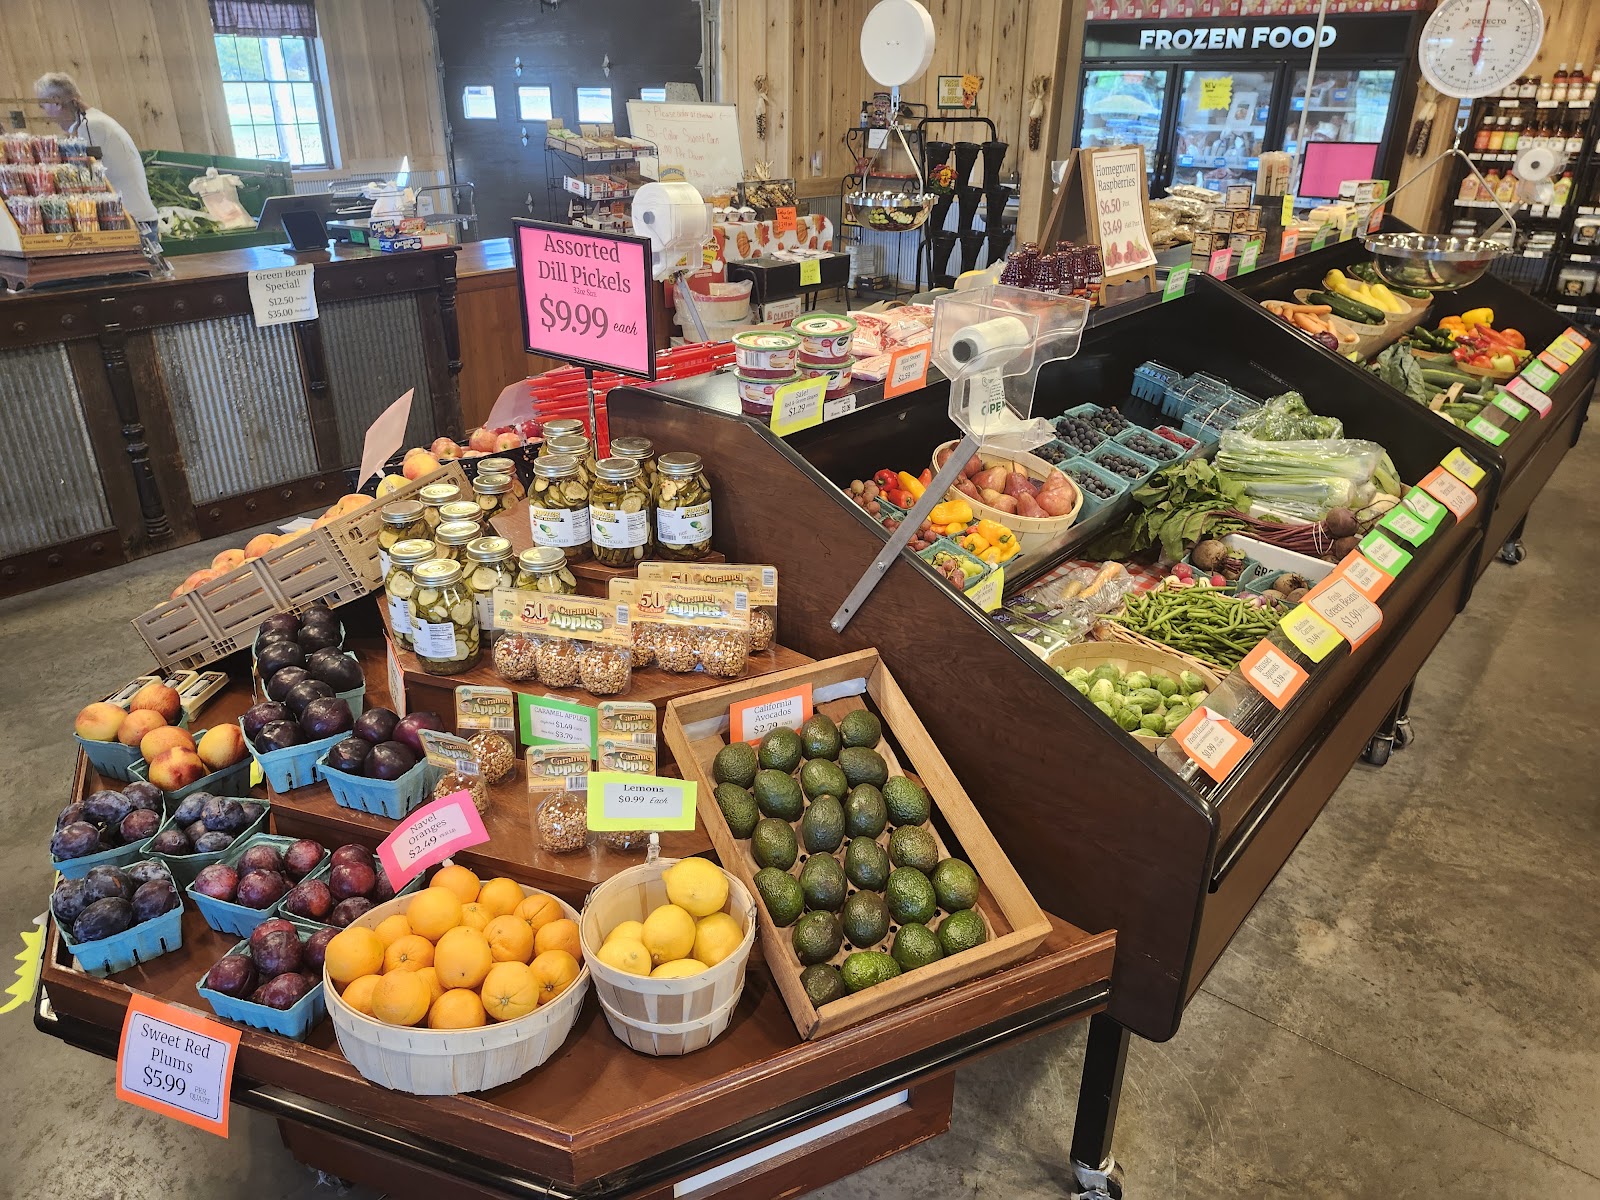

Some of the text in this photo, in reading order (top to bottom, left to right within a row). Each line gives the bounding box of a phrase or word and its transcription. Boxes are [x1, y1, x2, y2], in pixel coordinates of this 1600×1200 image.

[1139, 25, 1337, 50] FROZEN FOOD
[1096, 163, 1136, 178] Homegrown
[1098, 176, 1136, 193] Raspberries
[1100, 198, 1120, 215] $6.50
[1102, 219, 1122, 236] $3.49
[544, 234, 620, 263] Assorted
[256, 269, 307, 281] Green Bean
[538, 260, 631, 294] Dill Pickels
[266, 279, 300, 293] Special!
[269, 296, 294, 307] $12.50
[268, 308, 293, 319] $35.00
[539, 293, 638, 339] $9.99 each
[774, 310, 794, 320] CLAEYS
[788, 404, 806, 418] $1.29
[1255, 565, 1273, 576] GR
[704, 573, 743, 583] Caramel
[640, 590, 715, 608] 50 Caramel
[1327, 591, 1342, 603] Fresh
[524, 600, 548, 620] 50
[557, 606, 598, 617] Caramel
[668, 600, 721, 616] Apples
[1324, 592, 1360, 618] Green Beans
[550, 612, 603, 631] Apples
[1340, 608, 1363, 628] $1.99
[1254, 655, 1272, 673] Brussel
[1262, 663, 1280, 679] Sprouts
[477, 697, 509, 705] Caramel
[754, 699, 792, 714] California
[472, 703, 507, 715] Apple
[534, 707, 588, 722] CARAMEL APPLES
[755, 709, 792, 722] Avocados
[556, 721, 572, 730] $1.49
[614, 720, 649, 732] Apple
[754, 722, 778, 734] $2.79
[556, 731, 573, 740] $3.79
[438, 746, 469, 759] Apple
[620, 752, 653, 761] Caramel
[550, 756, 587, 765] Caramel
[615, 758, 650, 771] Apple
[545, 764, 584, 776] Apple
[623, 784, 664, 793] Lemons
[618, 796, 668, 804] $0.99 Each
[410, 813, 437, 834] Navel
[408, 819, 447, 845] Oranges
[409, 836, 437, 859] $2.49
[141, 1023, 211, 1059] Sweet Red
[151, 1047, 193, 1074] Plums
[143, 1064, 186, 1096] $5.99
[189, 1093, 211, 1105] QUART
